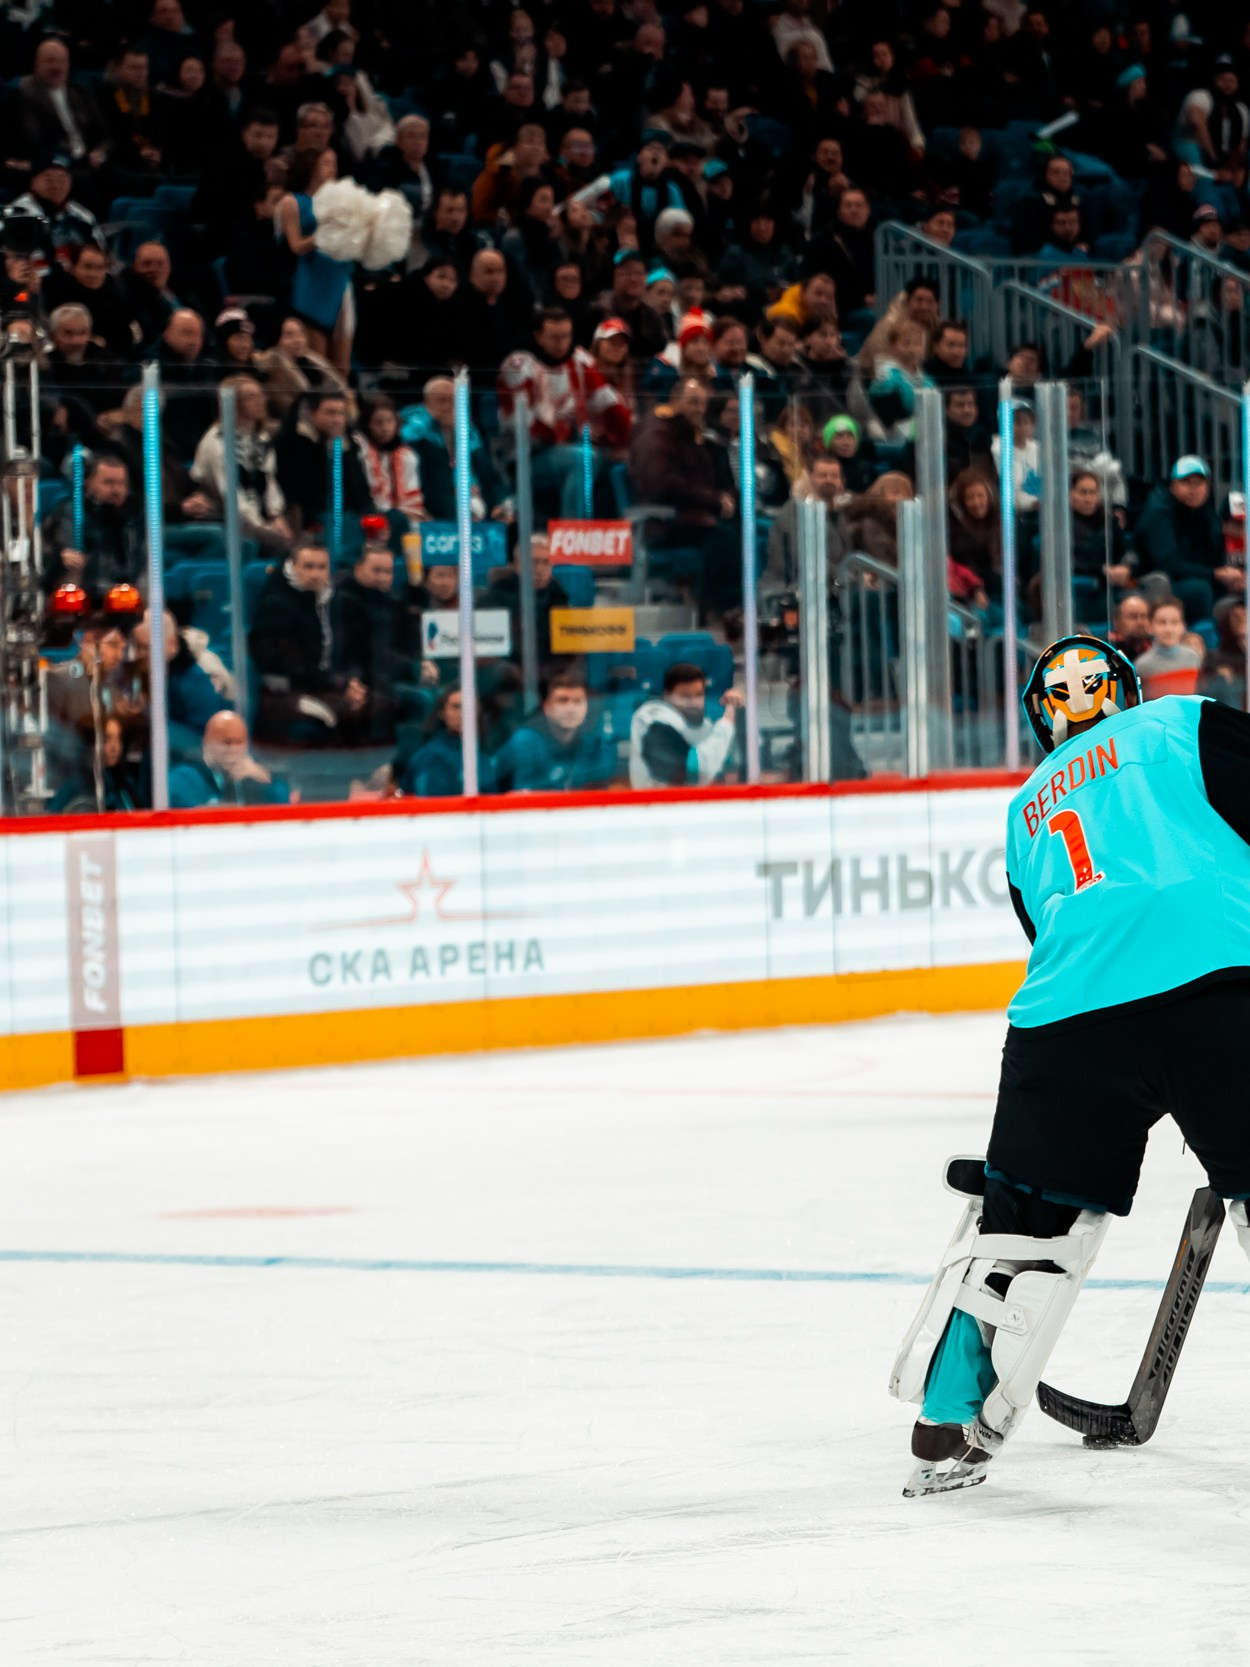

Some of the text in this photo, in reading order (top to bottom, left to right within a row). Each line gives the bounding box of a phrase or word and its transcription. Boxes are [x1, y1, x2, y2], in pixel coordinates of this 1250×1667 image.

[549, 528, 630, 557] FONBET
[1022, 737, 1119, 838] BERDIN
[1047, 808, 1106, 895] 1
[79, 853, 103, 1013] FONBET
[309, 938, 546, 988] СКА АРЕНА
